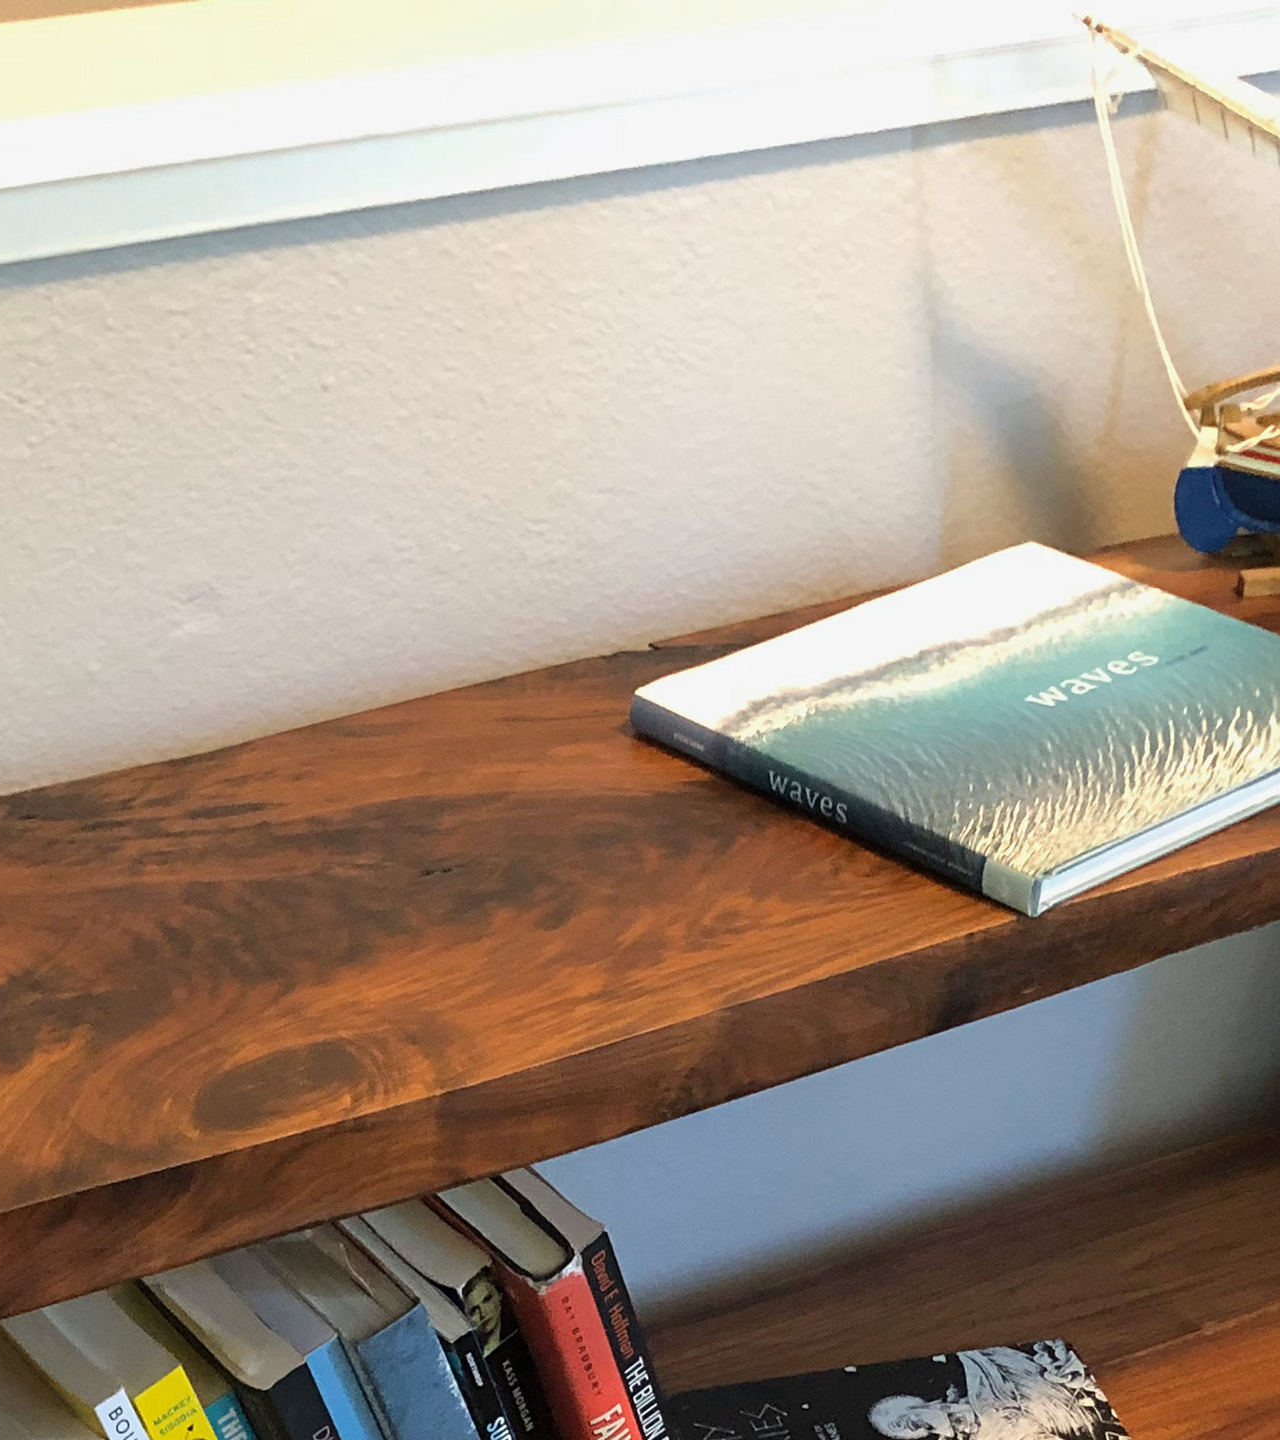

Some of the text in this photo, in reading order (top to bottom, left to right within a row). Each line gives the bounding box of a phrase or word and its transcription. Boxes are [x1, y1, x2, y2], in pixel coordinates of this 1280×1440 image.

[1023, 650, 1160, 707] waves
[768, 770, 849, 824] waves
[590, 1249, 611, 1292] David
[607, 1302, 635, 1359] Hoffman
[561, 1294, 605, 1398] RAY BRADBURY
[624, 1356, 644, 1389] THE
[152, 1394, 196, 1428] MACKEY
[501, 1358, 535, 1433] KASS MORGAN
